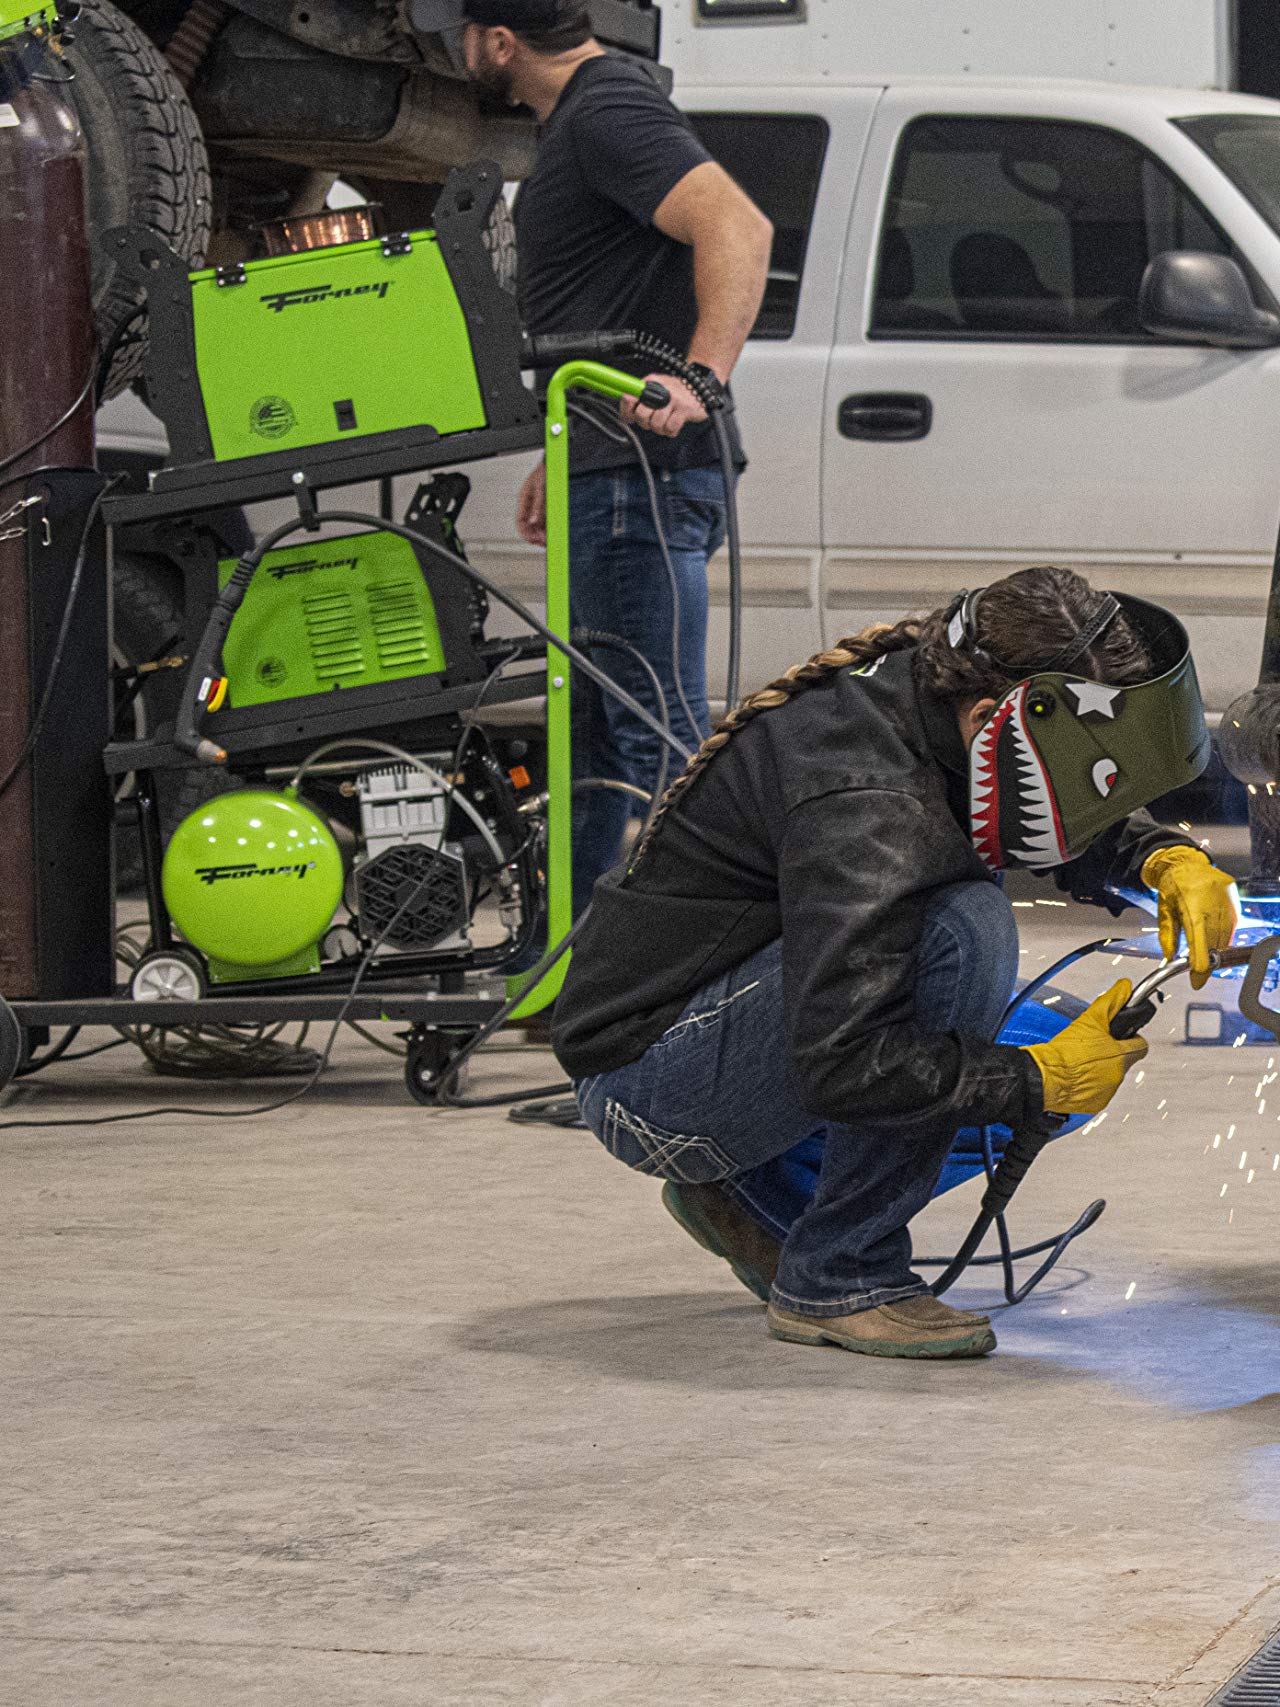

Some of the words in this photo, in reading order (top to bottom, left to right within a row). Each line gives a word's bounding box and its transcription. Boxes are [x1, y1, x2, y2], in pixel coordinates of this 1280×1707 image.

[260, 281, 389, 313] Forney
[267, 557, 358, 580] Forney
[195, 863, 308, 885] Forney
